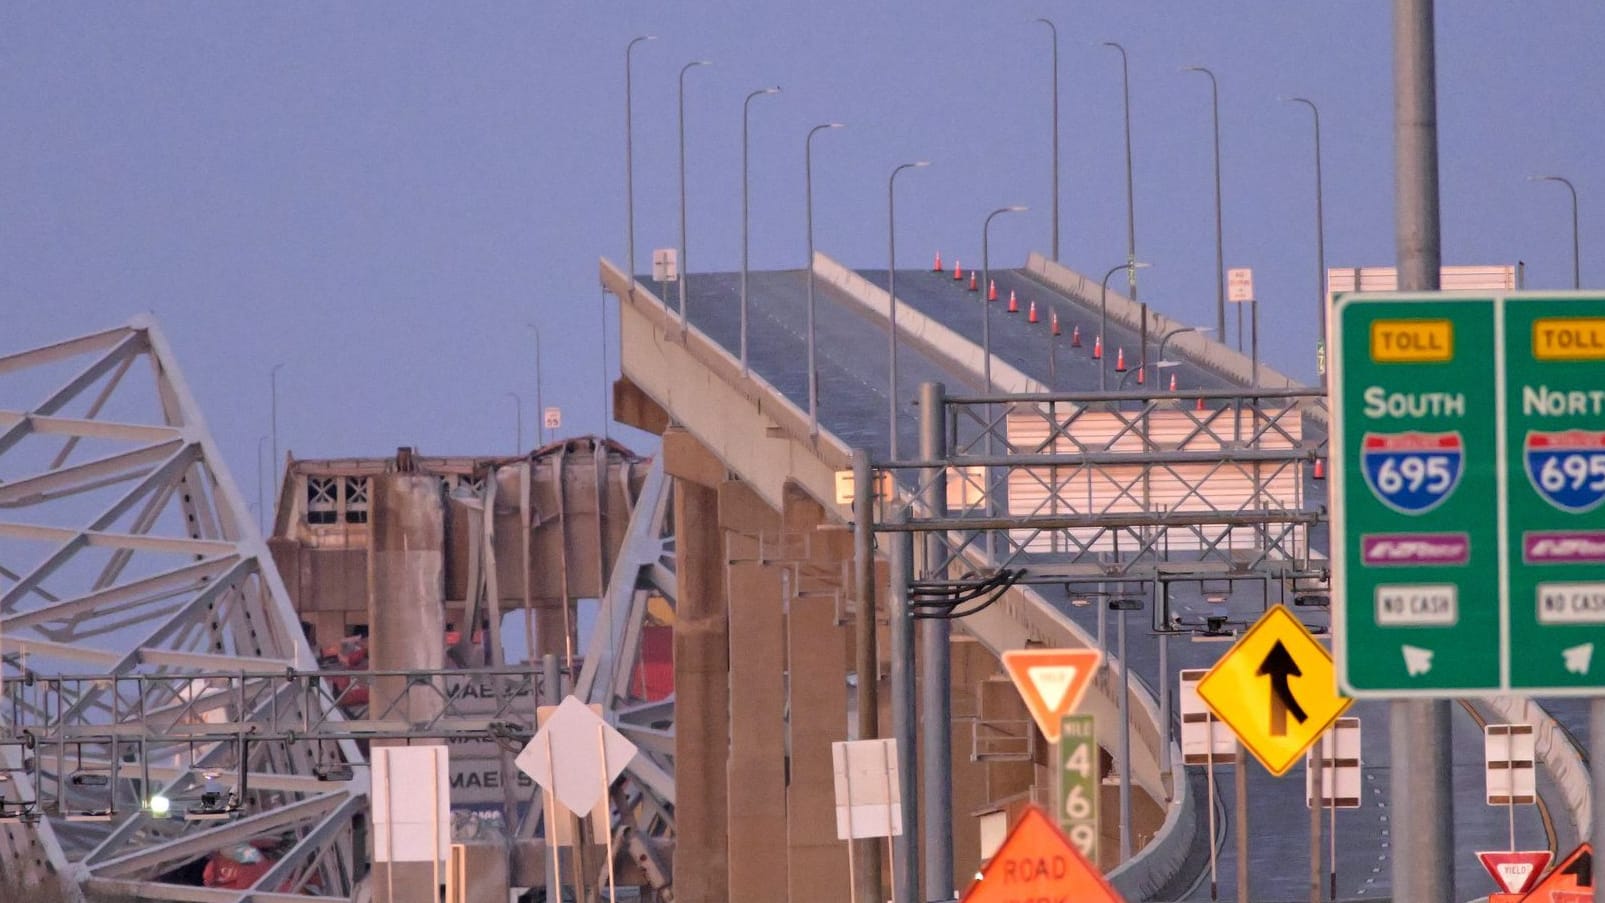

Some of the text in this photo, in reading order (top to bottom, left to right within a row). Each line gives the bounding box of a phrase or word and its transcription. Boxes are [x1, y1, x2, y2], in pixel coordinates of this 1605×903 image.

[1381, 331, 1443, 350] TOLL
[1543, 329, 1604, 349] TOLL
[1363, 386, 1466, 418] SOUTH
[1522, 385, 1605, 416] NORT
[1377, 456, 1451, 494] 695
[1540, 455, 1605, 493] 695
[1384, 596, 1449, 614] NO CASH
[1545, 594, 1605, 612] NO CAS
[1003, 855, 1067, 884] ROAD
[1504, 866, 1526, 875] YIELD
